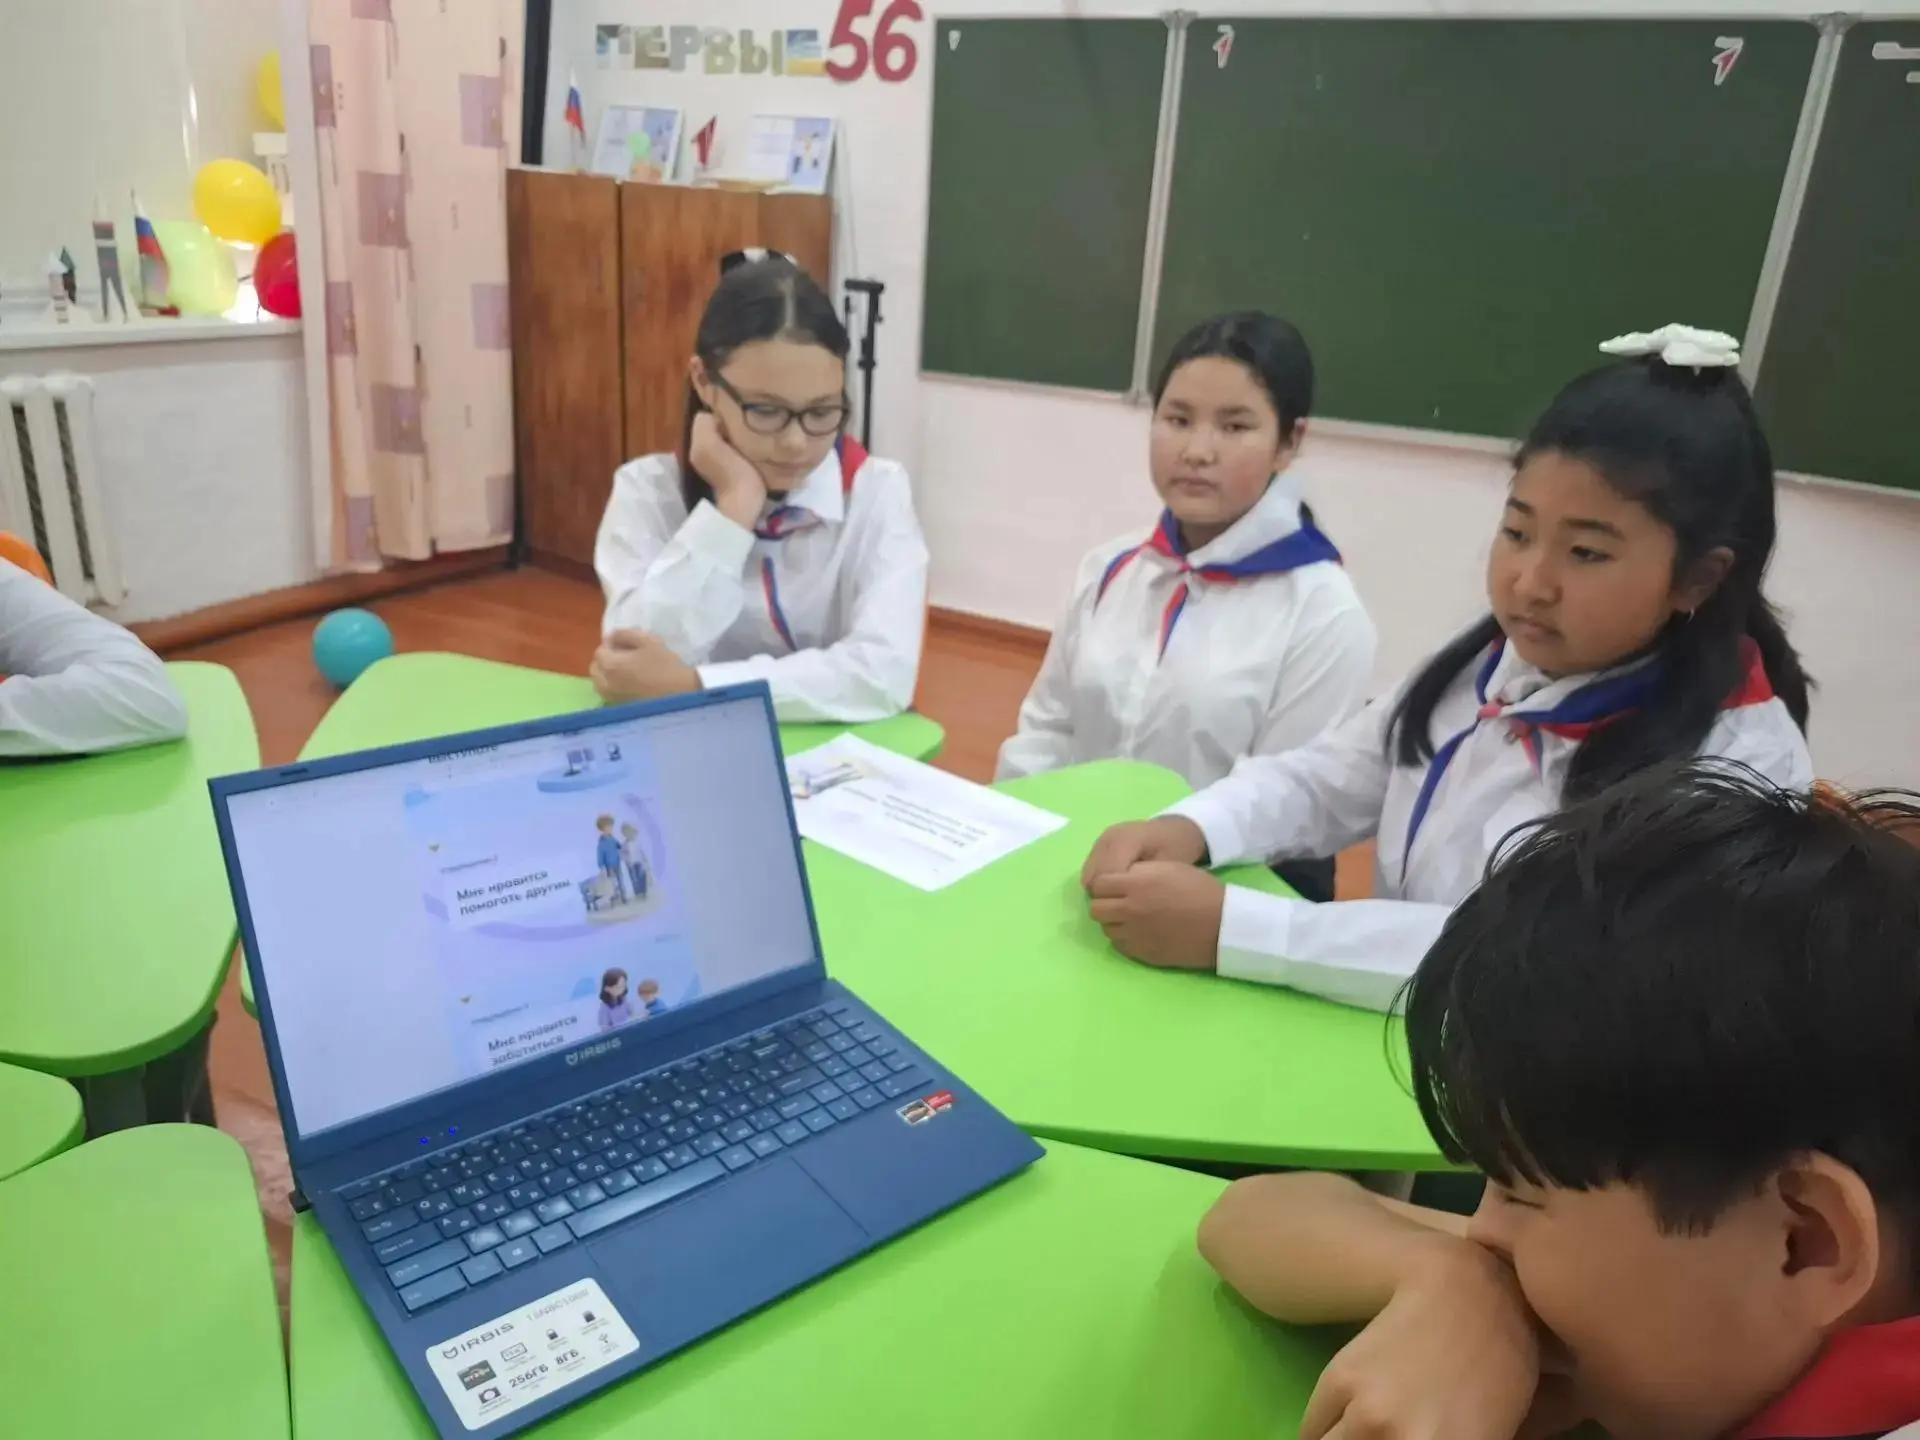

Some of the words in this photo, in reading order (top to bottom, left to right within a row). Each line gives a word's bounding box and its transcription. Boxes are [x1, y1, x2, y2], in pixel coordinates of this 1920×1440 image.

[596, 23, 828, 76] ПЕРВЫЕ
[825, 0, 924, 83] 56
[456, 888, 485, 902] Мне
[488, 1036, 516, 1051] Мне
[460, 1322, 514, 1352] IRBIS
[556, 1348, 579, 1365] 8ГБ
[508, 1363, 549, 1388] 256ГБ
